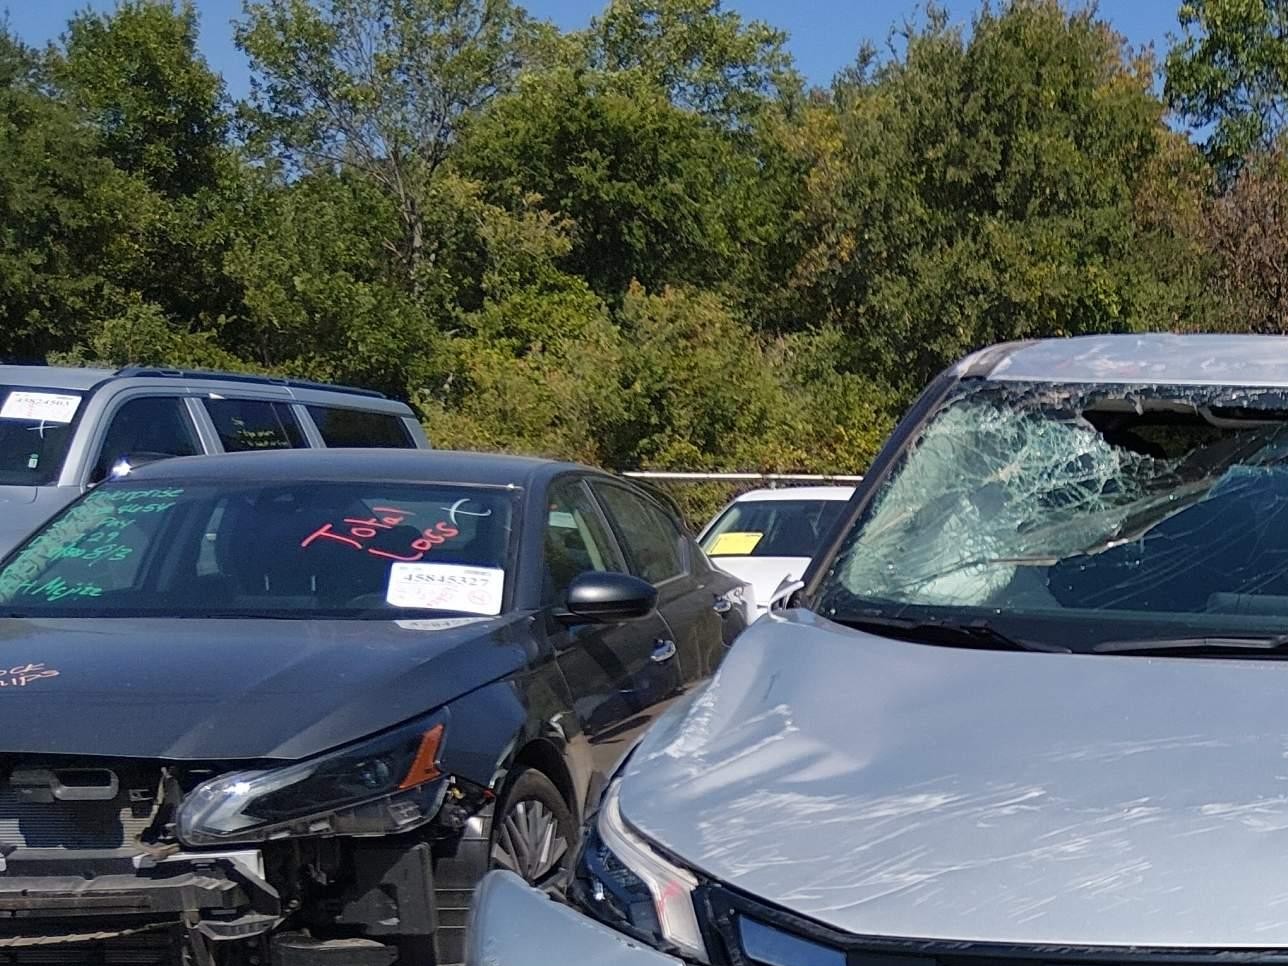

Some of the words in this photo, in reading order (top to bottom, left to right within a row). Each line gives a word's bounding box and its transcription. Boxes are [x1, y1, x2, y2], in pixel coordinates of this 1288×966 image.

[301, 506, 417, 550] Total
[367, 521, 459, 561] Loss
[402, 573, 490, 587] 45845327
